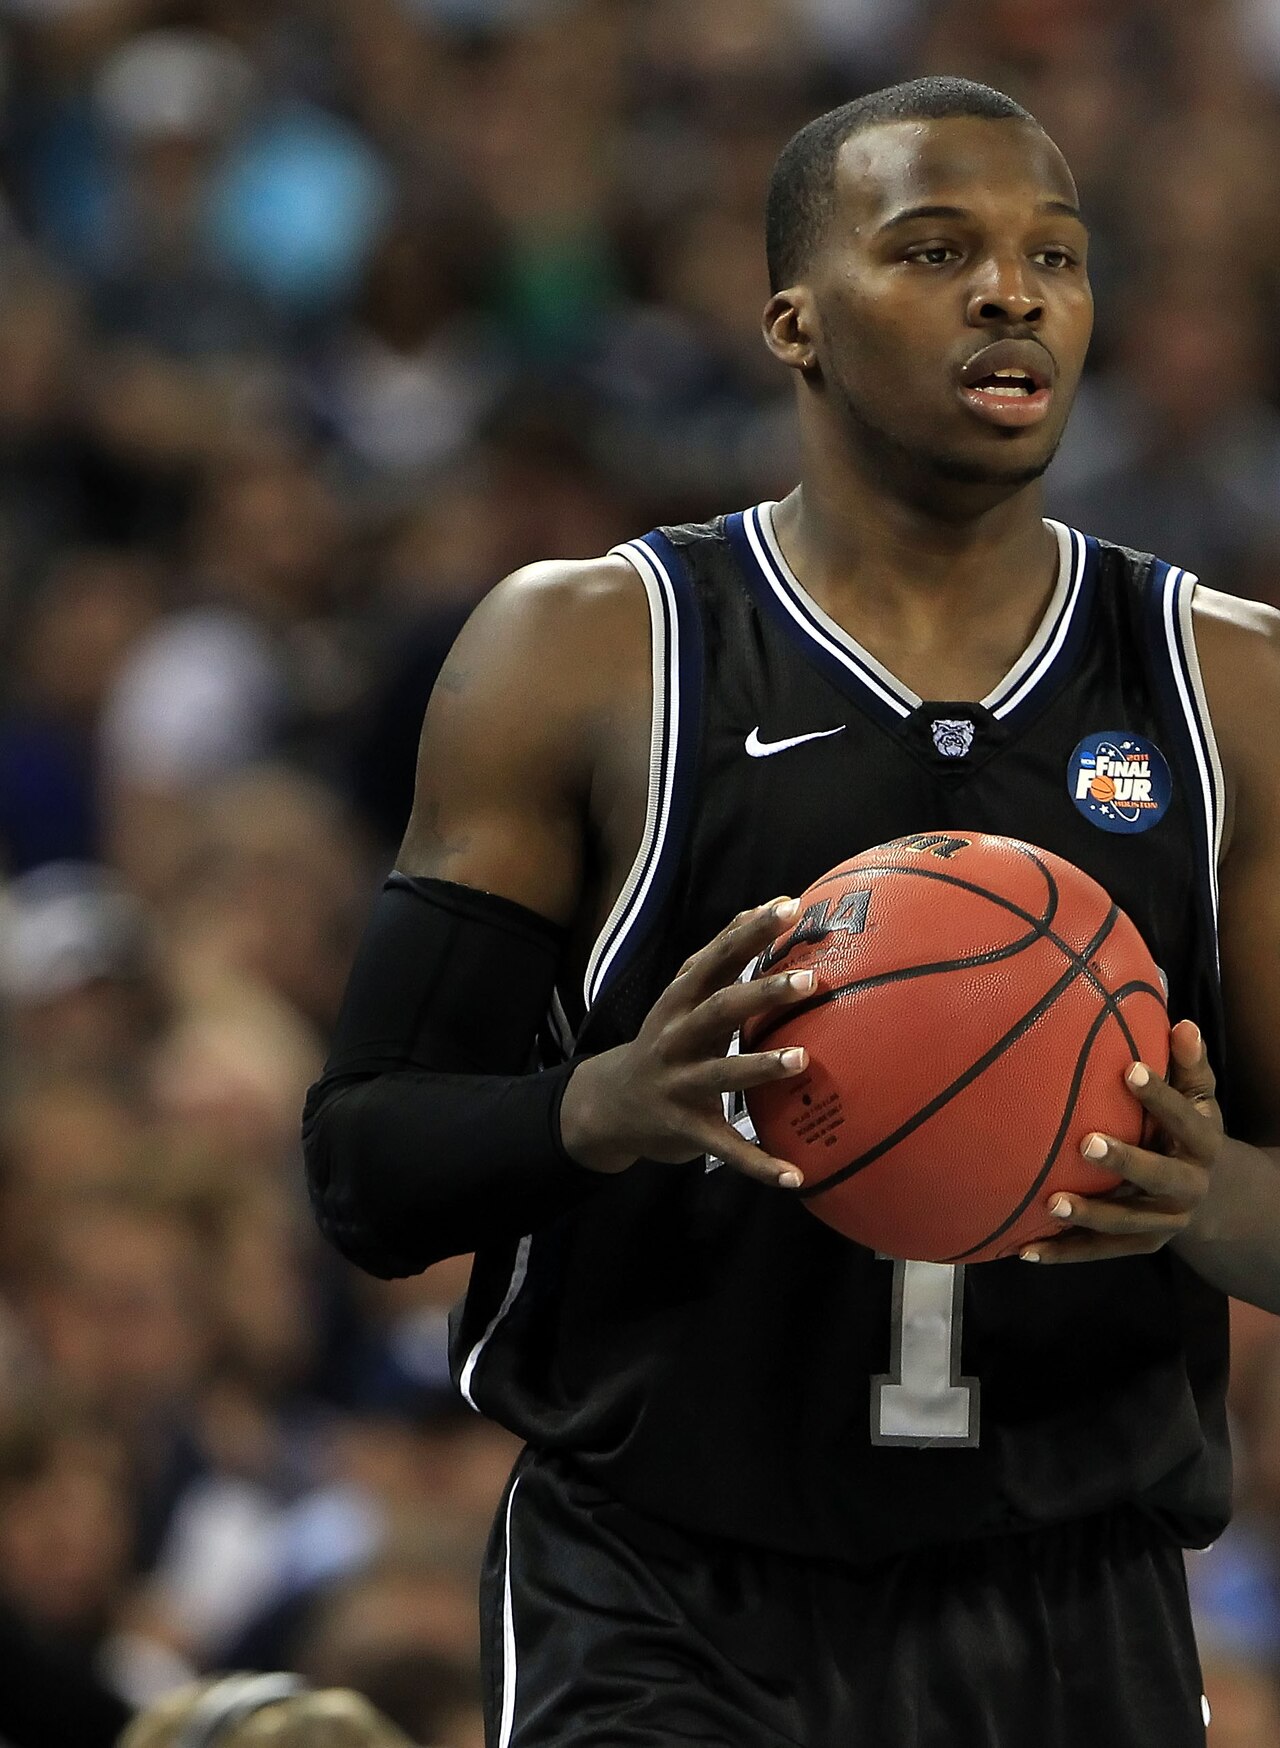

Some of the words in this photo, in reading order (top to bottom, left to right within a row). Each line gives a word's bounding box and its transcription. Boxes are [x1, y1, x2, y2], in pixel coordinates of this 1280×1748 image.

[1096, 755, 1151, 778] FINAL
[1126, 754, 1149, 762] 2011
[869, 1250, 982, 1449] 1
